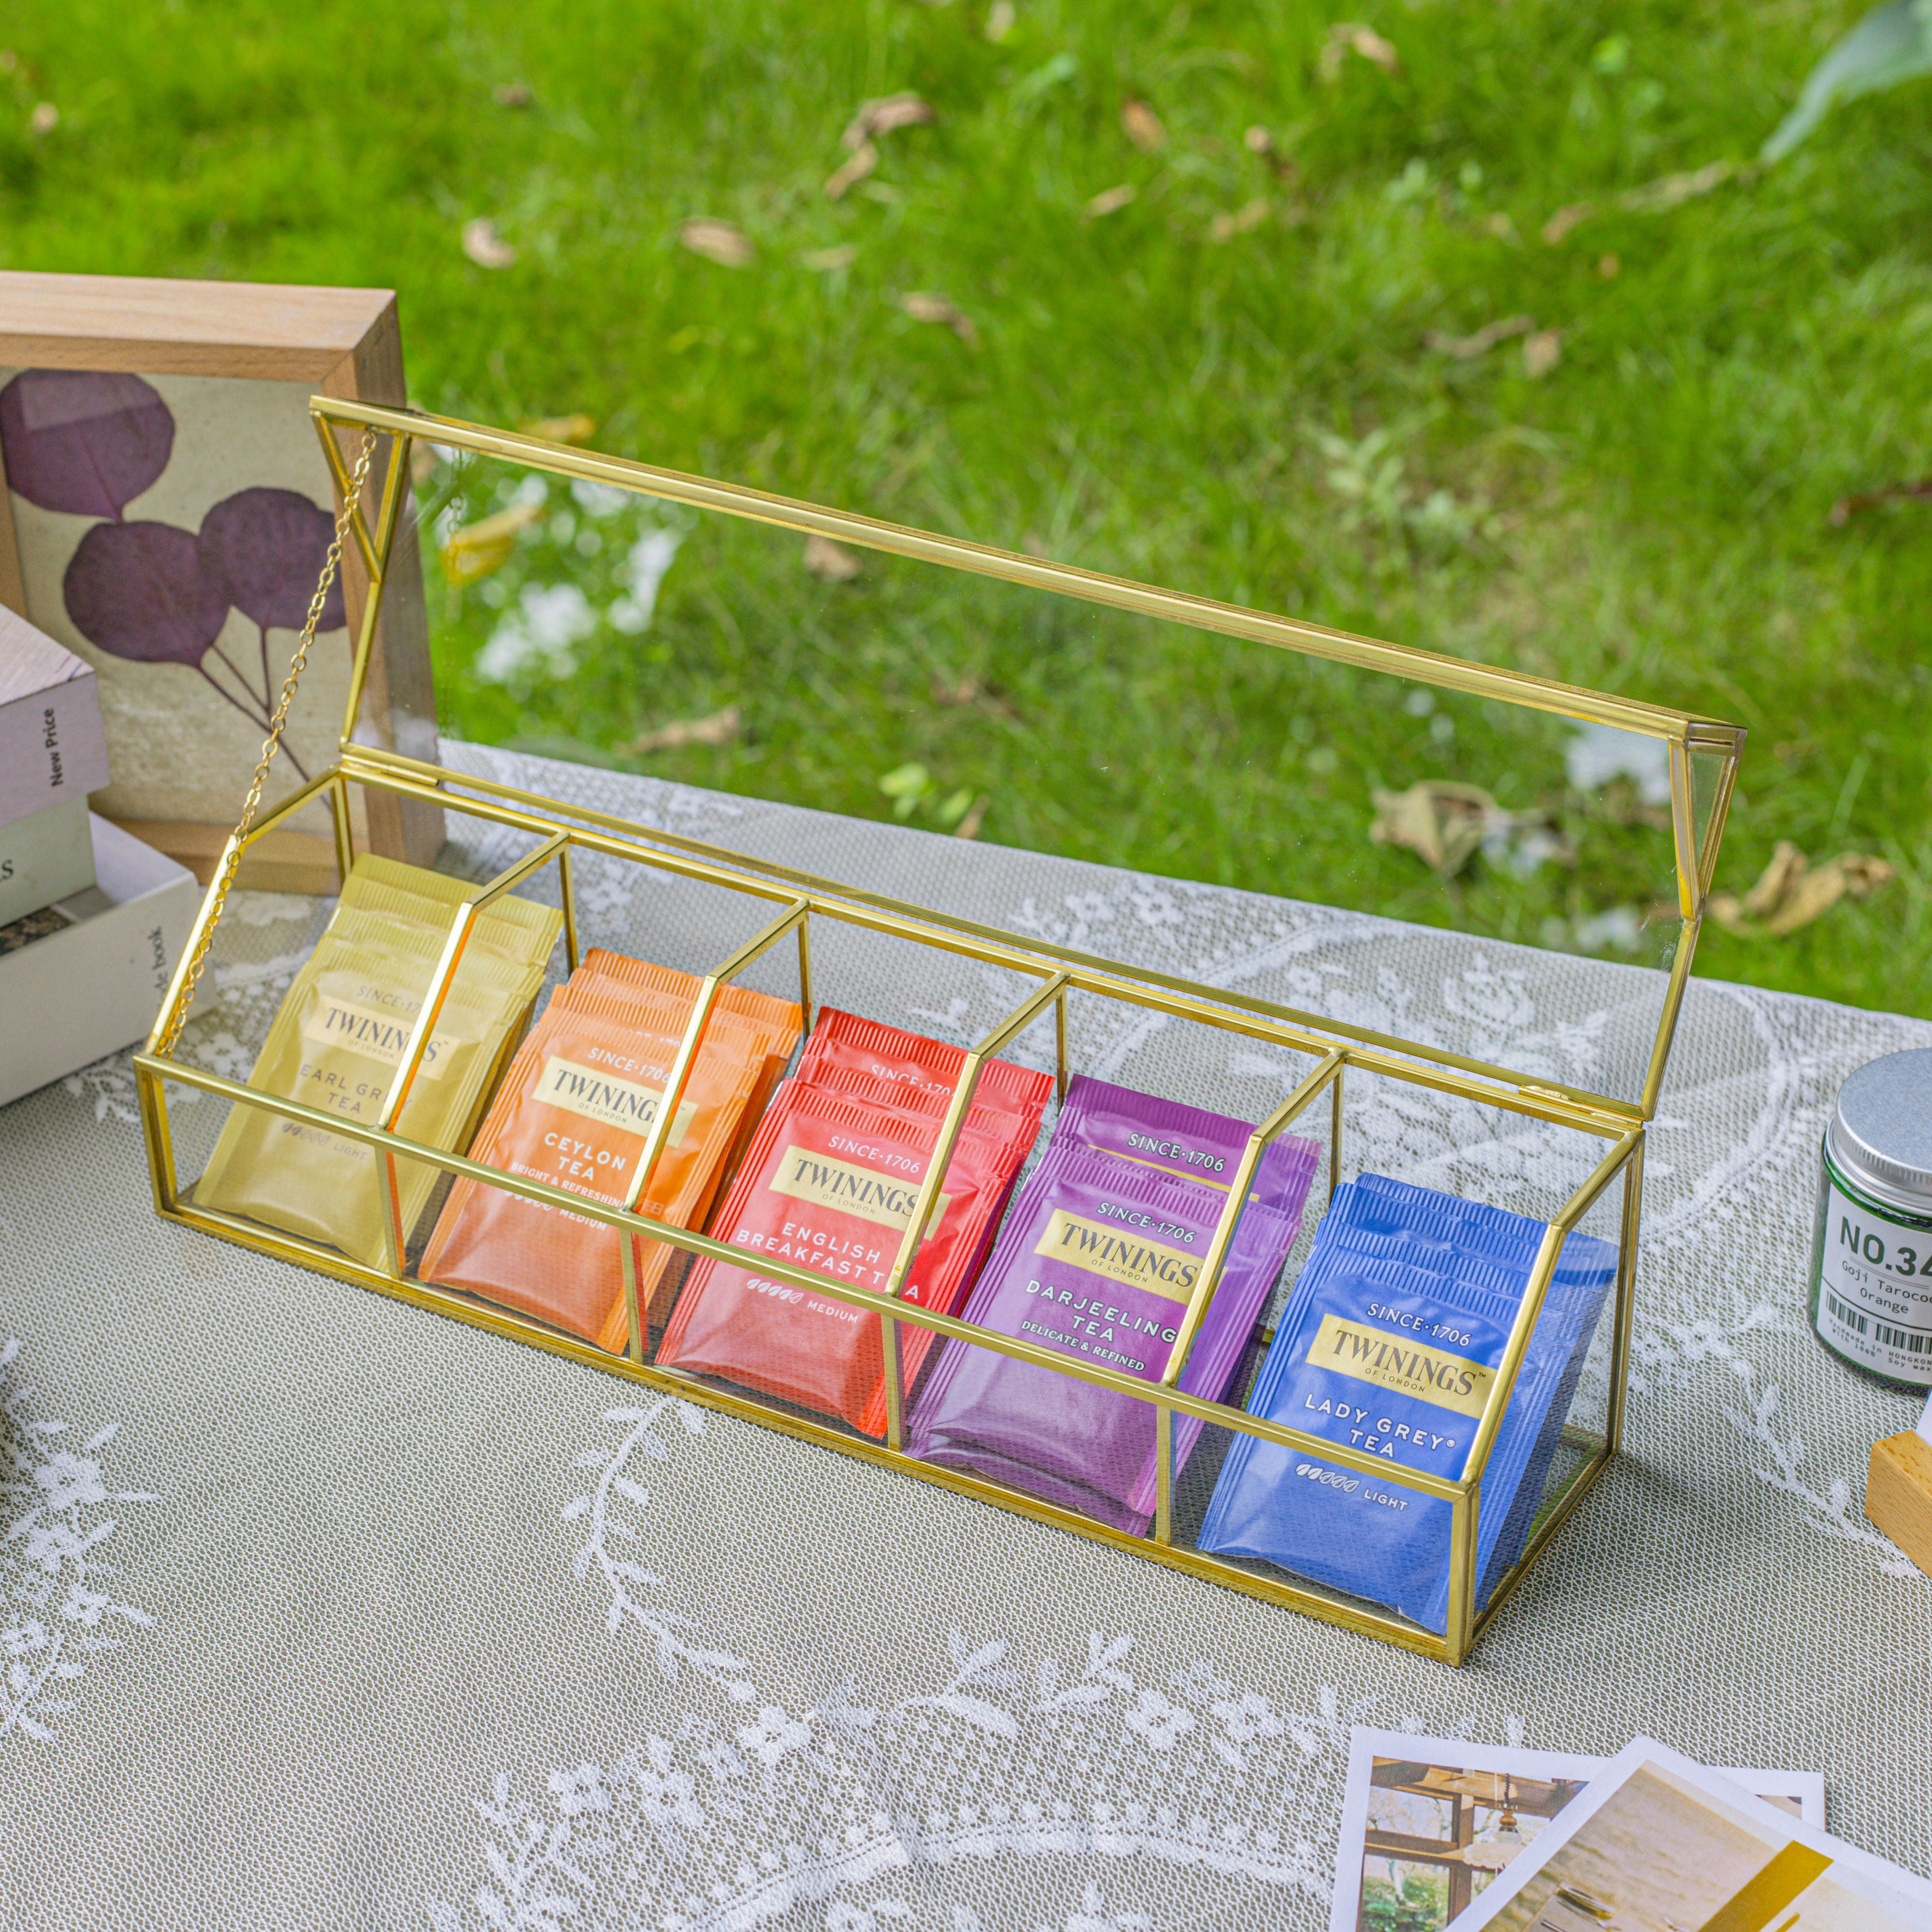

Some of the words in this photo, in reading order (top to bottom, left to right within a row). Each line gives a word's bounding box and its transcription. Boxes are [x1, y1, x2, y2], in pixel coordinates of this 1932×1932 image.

[43, 707, 58, 748] Price
[50, 751, 64, 787] New
[324, 1007, 442, 1063] TWININS
[361, 1045, 394, 1059] LONDON
[300, 1064, 346, 1089] EARL
[356, 1083, 412, 1109] GRY
[327, 1092, 361, 1114] TEA
[579, 1103, 590, 1111] OF
[592, 1107, 628, 1123] LONDON
[334, 1142, 367, 1159] LIGHT
[544, 1132, 626, 1171] CEYLON
[511, 1162, 550, 1182] BRIGHT
[551, 1176, 559, 1186] &
[558, 1156, 594, 1180] TEA
[794, 1159, 920, 1217] TWININGS
[823, 1193, 835, 1202] OF
[837, 1198, 876, 1214] LONDON
[559, 1208, 607, 1231] MEDIUM
[736, 1230, 867, 1278] BREAKFAST
[782, 1222, 881, 1263] ENGLISH
[1091, 1259, 1104, 1268] OF
[1108, 1263, 1148, 1283] LONDON
[1842, 1261, 1868, 1283] Goji
[807, 1300, 858, 1323] MEDIUM
[1025, 1279, 1178, 1343] DARJEELING
[1860, 1288, 1909, 1314] Orange
[1072, 1315, 1114, 1342] TEA
[1829, 1318, 1865, 1345] Handmade
[1872, 1344, 1882, 1353] in
[1021, 1320, 1079, 1348] DELICATE
[1080, 1341, 1089, 1352] &
[1092, 1345, 1146, 1371] REFINED
[1888, 1357, 1905, 1368] Soy
[1365, 1368, 1378, 1377] OF
[1382, 1374, 1425, 1392] LONDON
[1305, 1393, 1369, 1424] LADY
[1349, 1429, 1394, 1458] TEA
[1363, 1490, 1408, 1511] LIGHT
